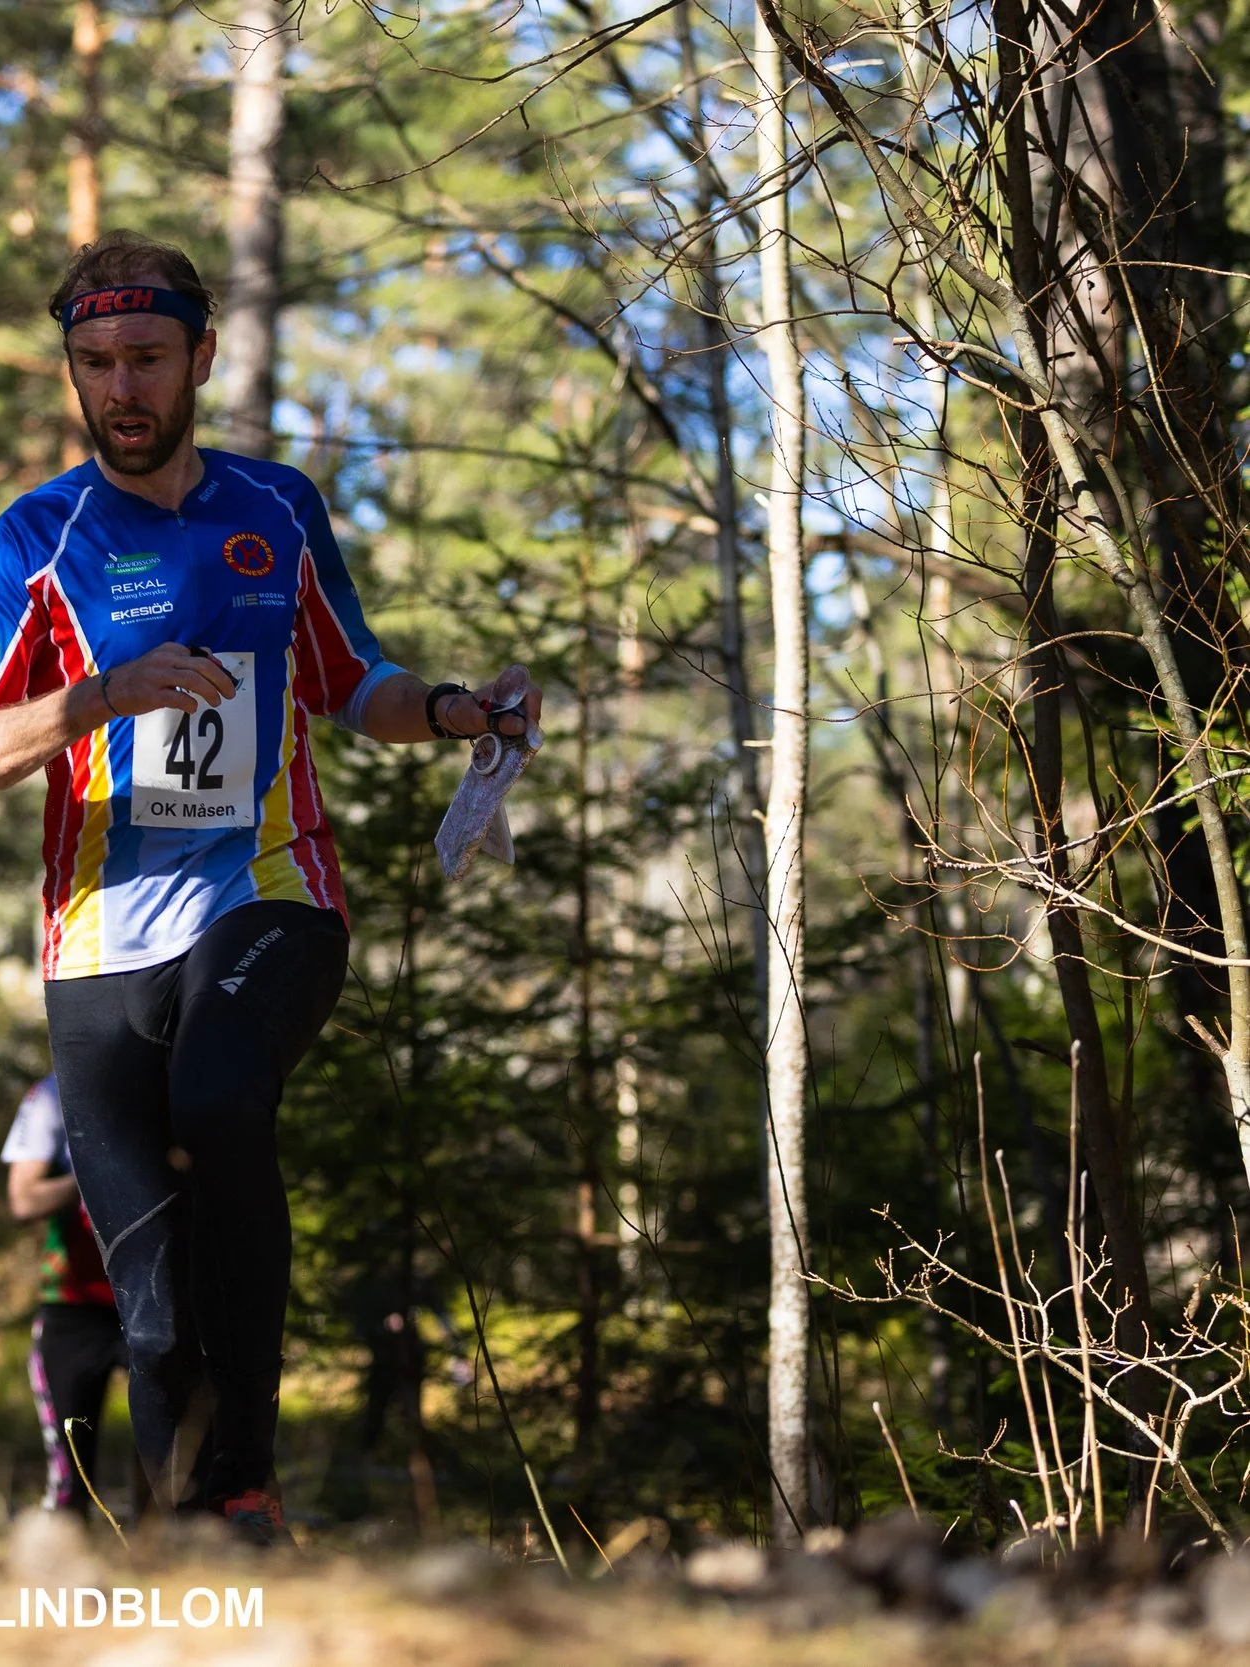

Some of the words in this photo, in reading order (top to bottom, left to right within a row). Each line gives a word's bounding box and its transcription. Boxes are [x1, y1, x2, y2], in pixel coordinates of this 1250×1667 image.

[224, 533, 274, 564] KLEMMINGEN
[111, 578, 166, 594] REKAL
[113, 592, 138, 602] Shining
[138, 588, 168, 598] Everyday
[165, 708, 224, 790] 42
[151, 801, 177, 817] OK
[182, 803, 236, 818] Måsen
[234, 948, 262, 972] TRUE
[255, 926, 285, 950] STORY
